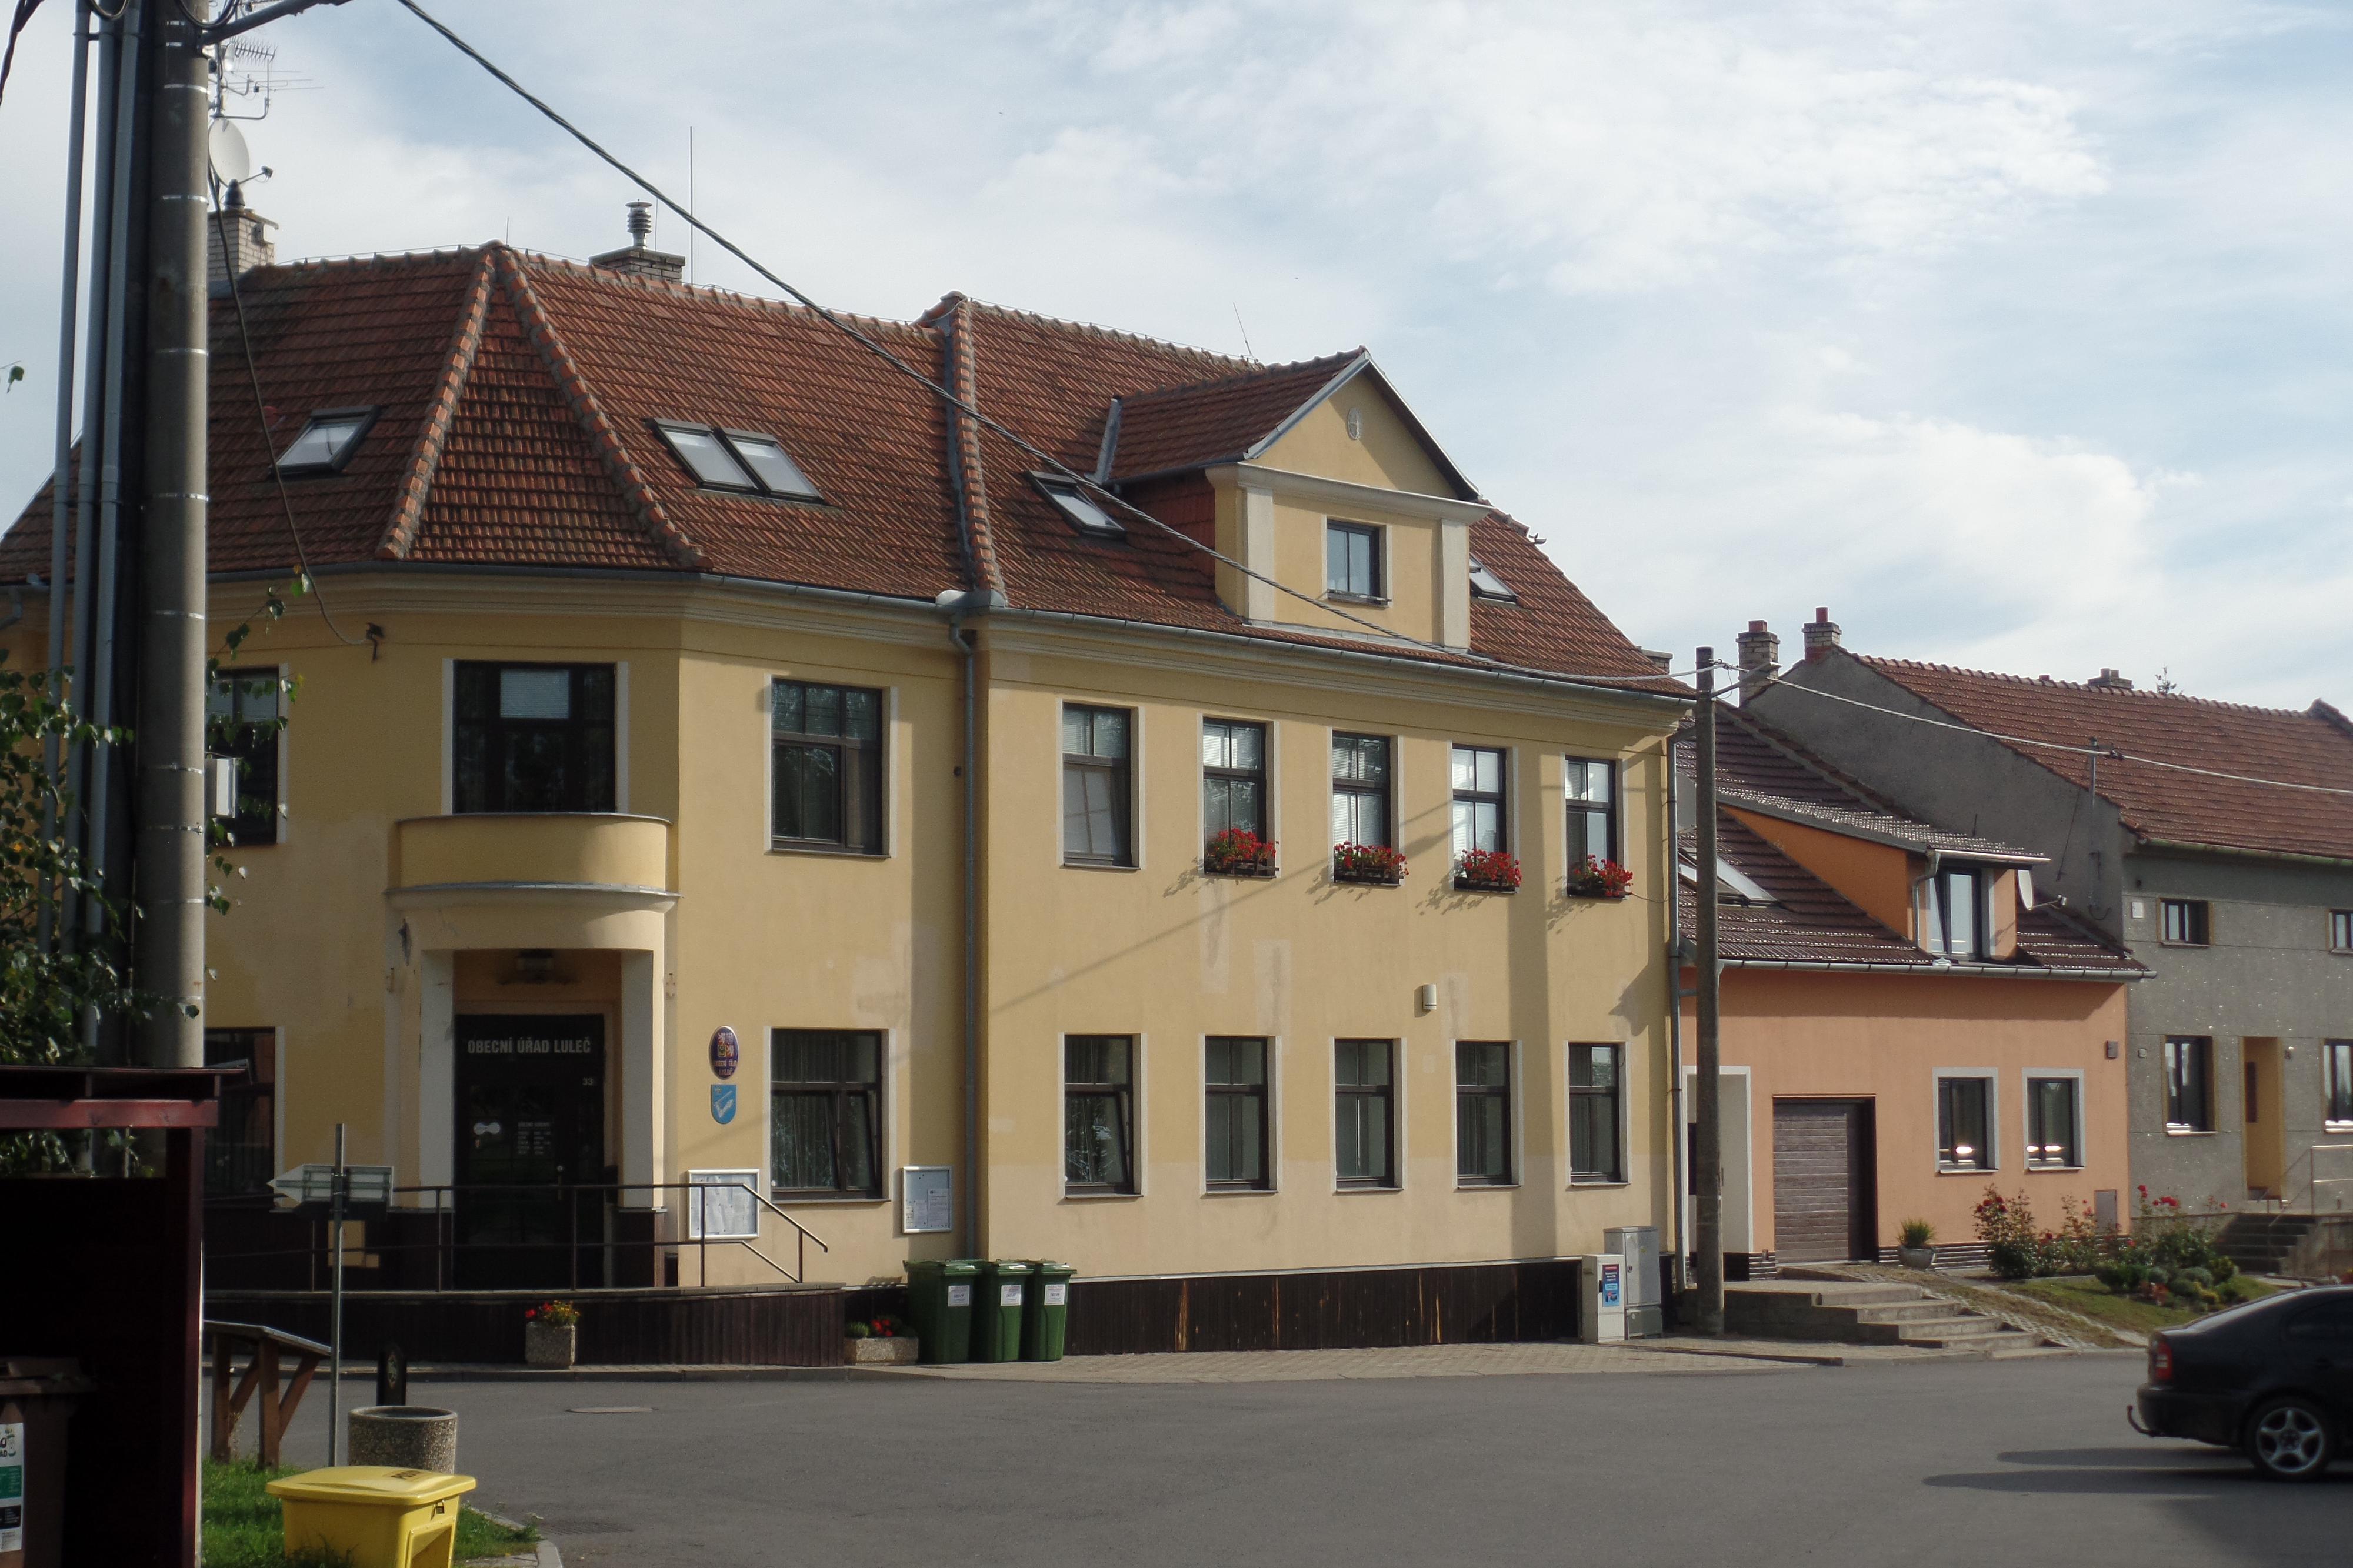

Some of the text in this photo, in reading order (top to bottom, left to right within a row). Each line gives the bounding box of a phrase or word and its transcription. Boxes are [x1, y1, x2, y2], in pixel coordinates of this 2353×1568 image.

[466, 1036, 591, 1053] OBECNÍ ÚŘAD LULEČ
[582, 1077, 594, 1086] 33
